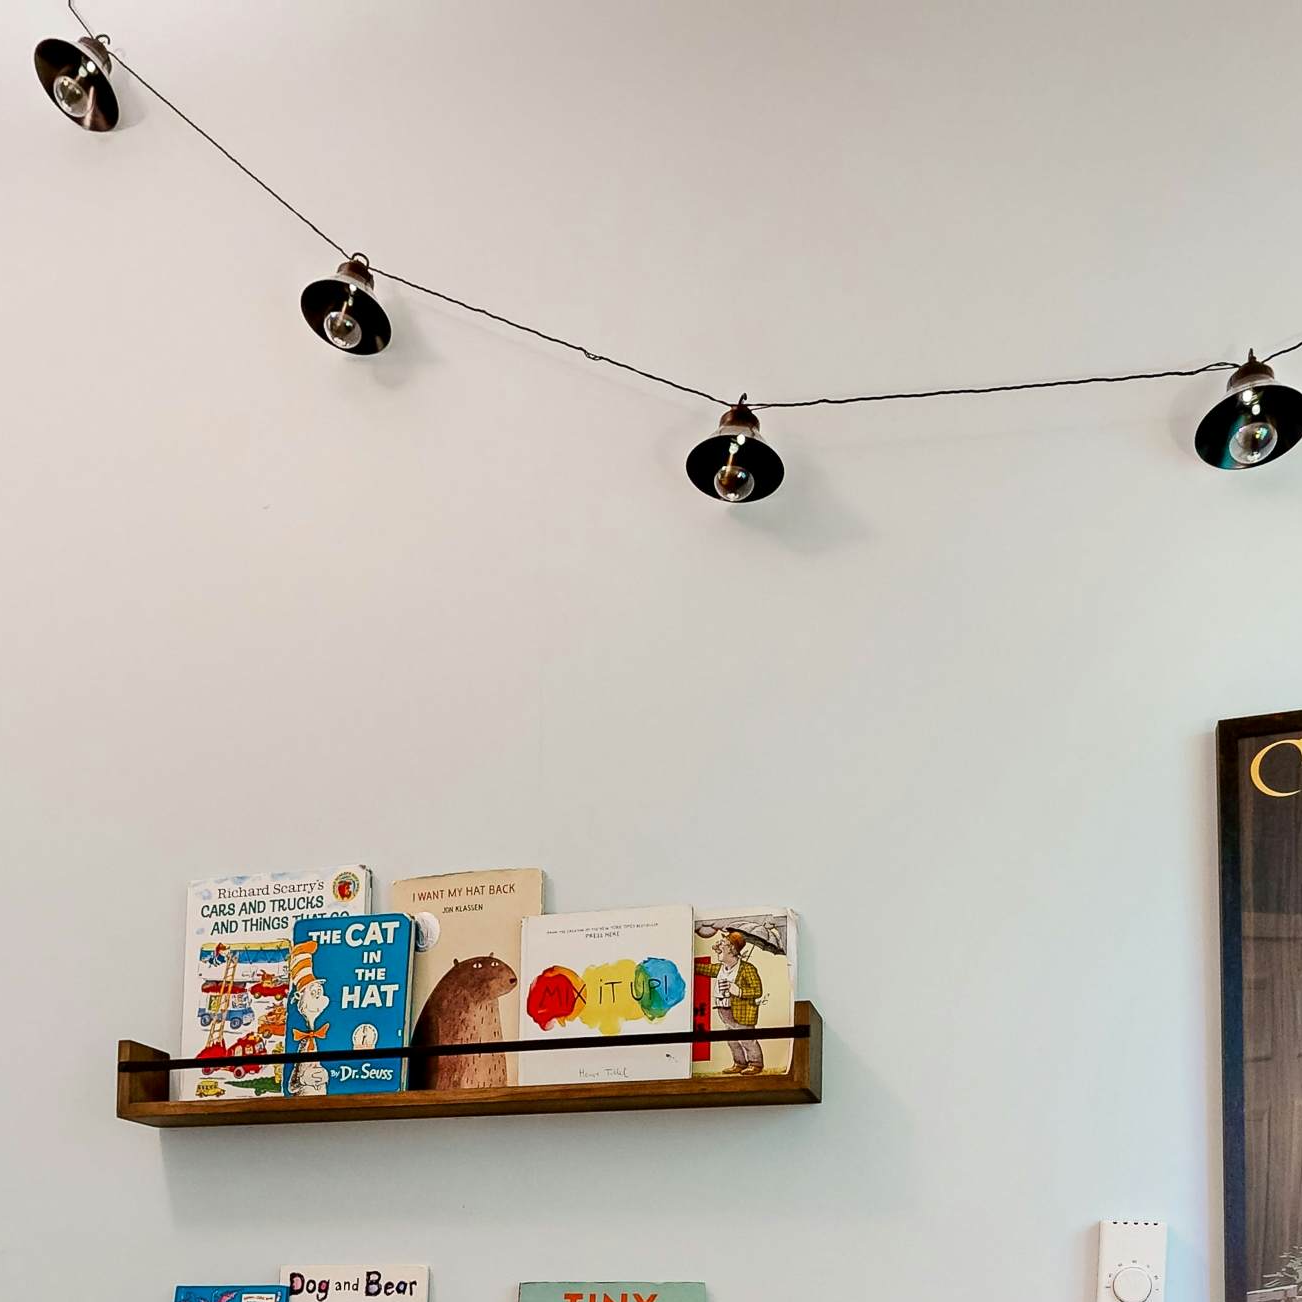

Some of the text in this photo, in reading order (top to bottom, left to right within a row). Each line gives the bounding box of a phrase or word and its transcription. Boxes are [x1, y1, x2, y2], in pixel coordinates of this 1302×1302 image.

[217, 884, 270, 899] Richard
[272, 879, 325, 897] Scarry's
[412, 882, 516, 902] I WANT MY HAT BACK
[200, 894, 324, 918] CARS AND TRUCKS
[455, 903, 484, 912] KLASSEN
[210, 919, 239, 936] AND
[308, 921, 400, 947] THE CAT
[362, 950, 382, 964] IN
[354, 968, 386, 981] THE
[341, 984, 399, 1009] HAT
[539, 984, 586, 1008] MIX
[630, 975, 670, 1001] UP!
[339, 1065, 360, 1081] Dr.
[361, 1063, 394, 1080] Seuss
[289, 1271, 418, 1302] Dog and Bear
